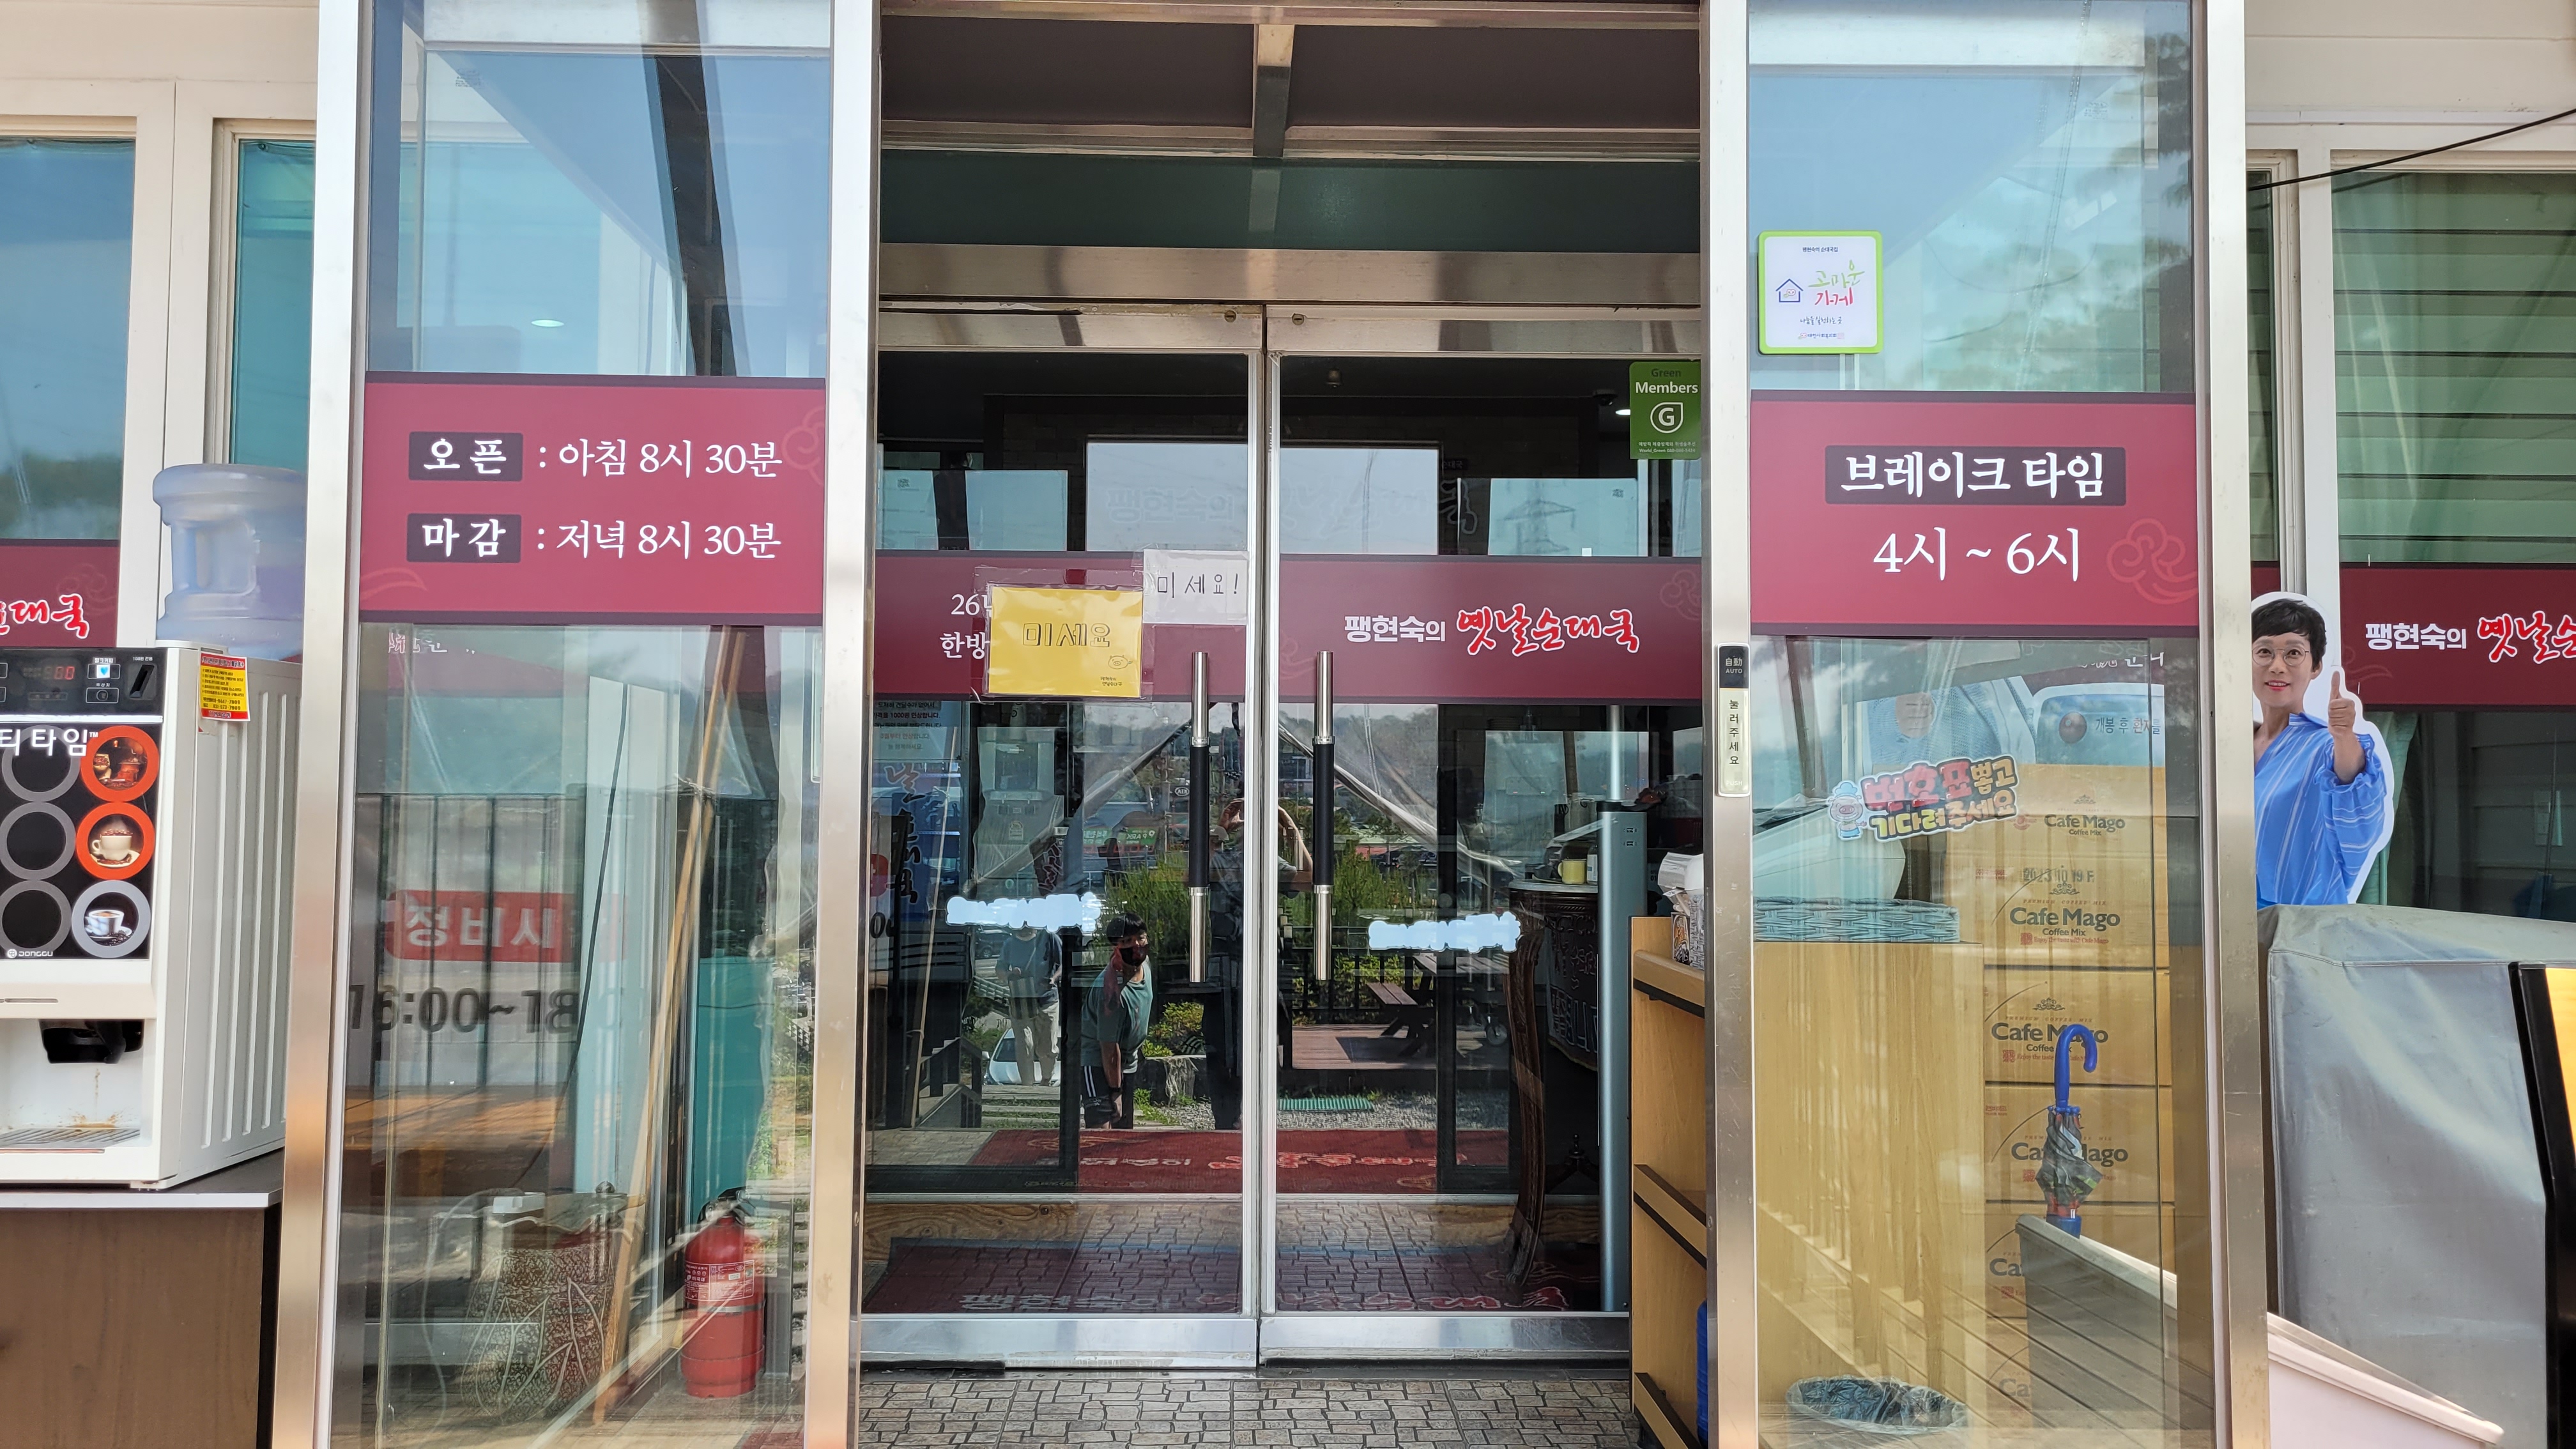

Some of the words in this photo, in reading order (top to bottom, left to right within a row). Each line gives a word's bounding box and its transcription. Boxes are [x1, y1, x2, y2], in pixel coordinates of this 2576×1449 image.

[1808, 259, 1865, 288] 고마운
[1814, 287, 1853, 306] 가게
[1651, 369, 1681, 377] Green
[1636, 381, 1698, 394] Members
[424, 438, 507, 474] 오픈
[559, 438, 625, 477] 아침
[640, 440, 692, 478] 8시
[705, 441, 782, 478] 30분
[1841, 452, 2011, 498] 브레이크
[2025, 452, 2104, 498] 타임
[422, 518, 505, 557] 마감
[556, 520, 625, 559] 저녁
[638, 521, 691, 560] 8시
[704, 523, 781, 559] 30분
[1873, 526, 1947, 581] 4시
[2007, 528, 2079, 582] 6시
[0, 593, 89, 639] 대국
[1344, 614, 1445, 643] 팽현숙의
[1456, 602, 1640, 657] 옛날순대국
[939, 631, 990, 660] 한방
[1023, 622, 1111, 647] 미세요
[2365, 622, 2466, 650] 팽현숙의
[1725, 657, 1743, 667] 自動
[1729, 700, 1740, 765] 눌러주세요
[2096, 717, 2115, 734] 개봉
[2119, 717, 2129, 734] 후
[1861, 760, 1973, 812] 번호표
[1970, 758, 2015, 795] 뽑고
[2044, 814, 2080, 828] Cafe
[2083, 815, 2126, 833] Mago
[2009, 907, 2059, 926] Cafe
[2062, 908, 2120, 931] Mago
[1991, 1022, 2043, 1041] Cafe
